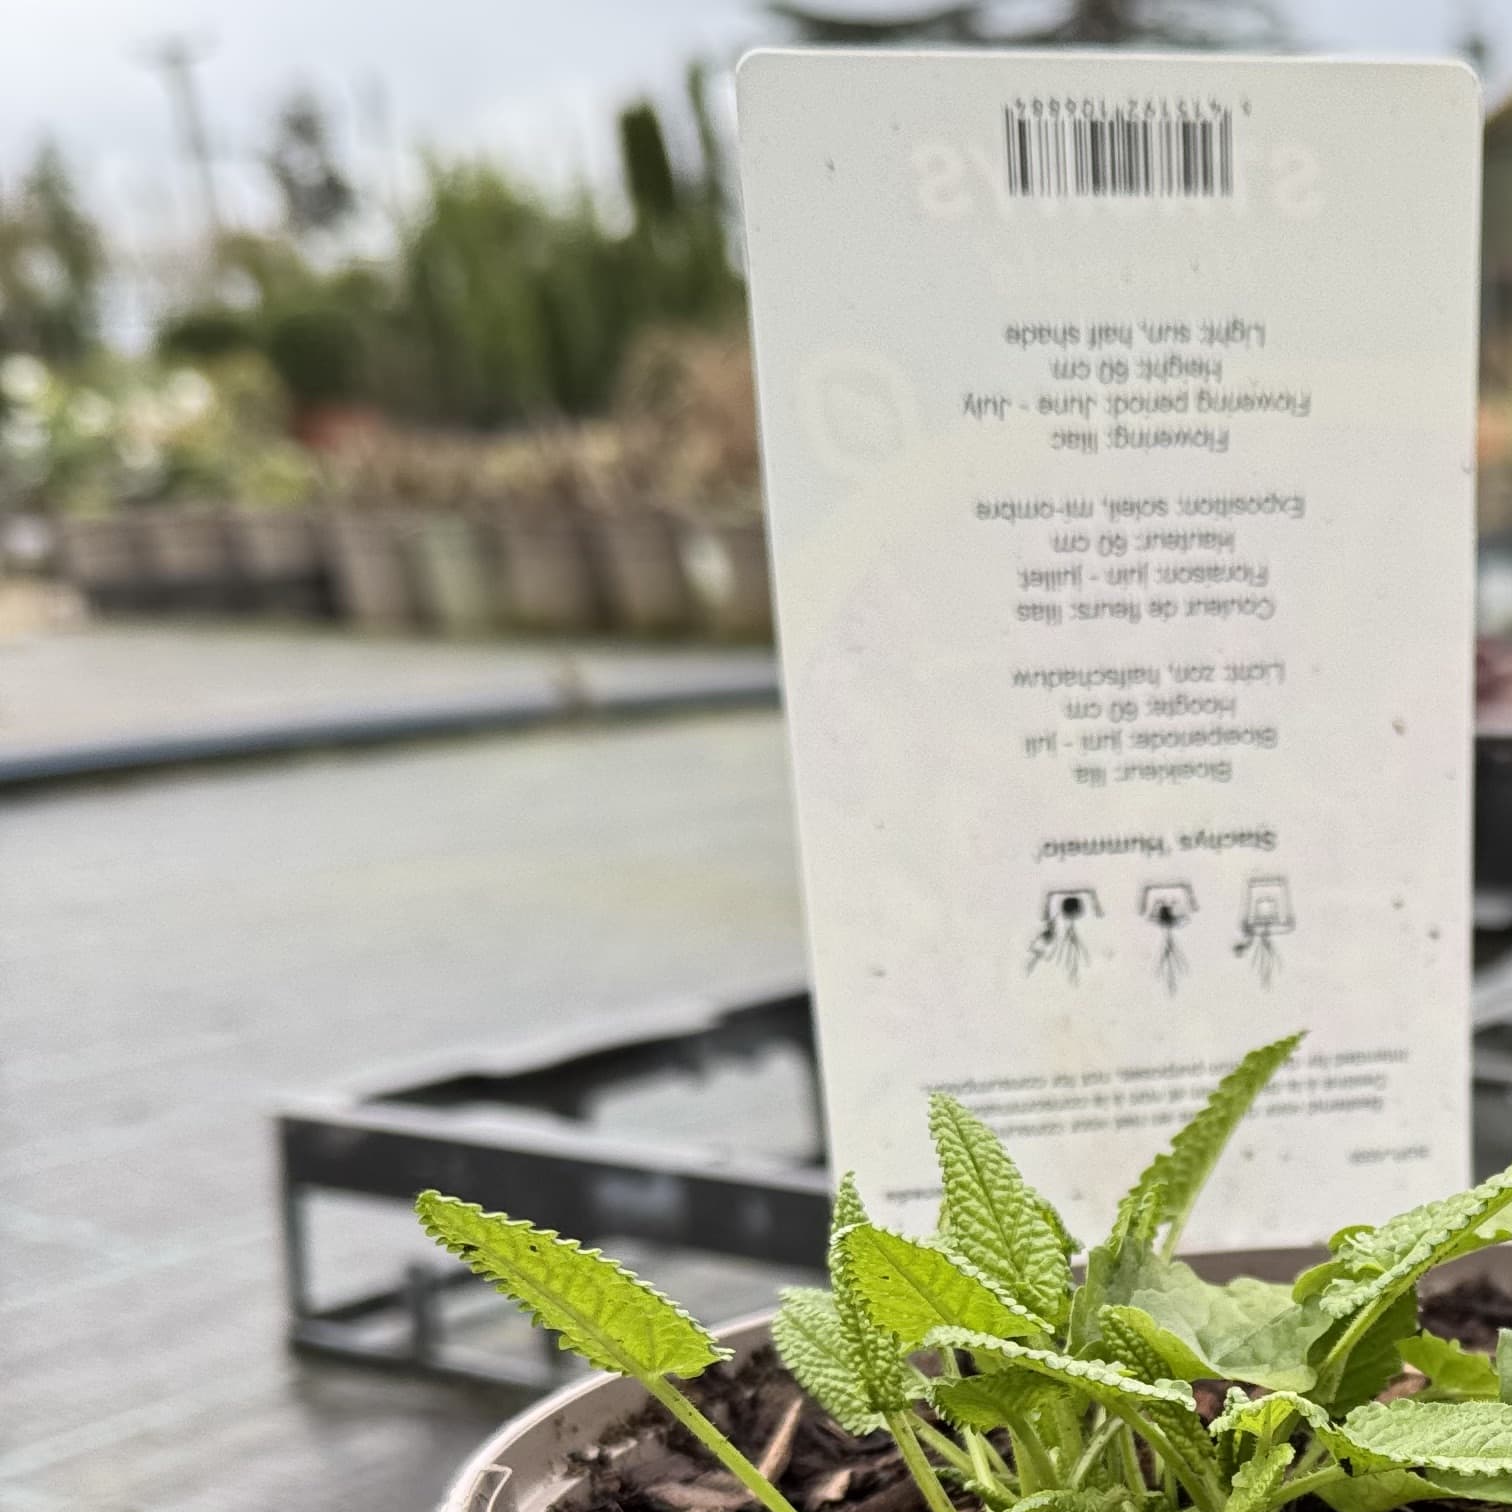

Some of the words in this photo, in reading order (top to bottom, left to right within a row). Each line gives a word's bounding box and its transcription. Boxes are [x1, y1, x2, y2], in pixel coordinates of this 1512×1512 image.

[1004, 326, 1080, 350] shade
[1087, 325, 1132, 349] half
[1138, 322, 1191, 347] sun,
[1200, 317, 1266, 349] Light:
[1051, 361, 1091, 381] cm
[1099, 361, 1129, 384] 60
[1136, 356, 1223, 383] Height:
[962, 393, 1012, 421] July
[1037, 396, 1097, 419] June
[1107, 393, 1189, 419] period:
[1199, 390, 1310, 417] Flowering
[1050, 431, 1099, 454] lilac
[1108, 425, 1230, 453] Flowering:
[974, 500, 1094, 525] mi-ombre
[1102, 496, 1169, 523] soleil,
[1178, 494, 1304, 520] Exposition:
[1053, 534, 1091, 554] cm
[1099, 534, 1128, 557] 60
[1134, 532, 1236, 555] Hauteur:
[1018, 565, 1082, 592] juillet
[1107, 563, 1149, 591] juin
[1157, 565, 1269, 589] Floraison:
[1016, 603, 1063, 626] lilas
[1072, 602, 1141, 624] fleurs:
[1150, 600, 1178, 622] de
[1186, 598, 1275, 621] Couleur
[1012, 668, 1160, 692] halfschaduw
[1168, 663, 1215, 684] zon,
[1066, 701, 1103, 720] cm
[1109, 701, 1139, 723] 60
[1024, 732, 1057, 760] juli
[1082, 729, 1122, 757] juni
[1072, 766, 1107, 789] lila
[1178, 830, 1277, 853] Stachys
